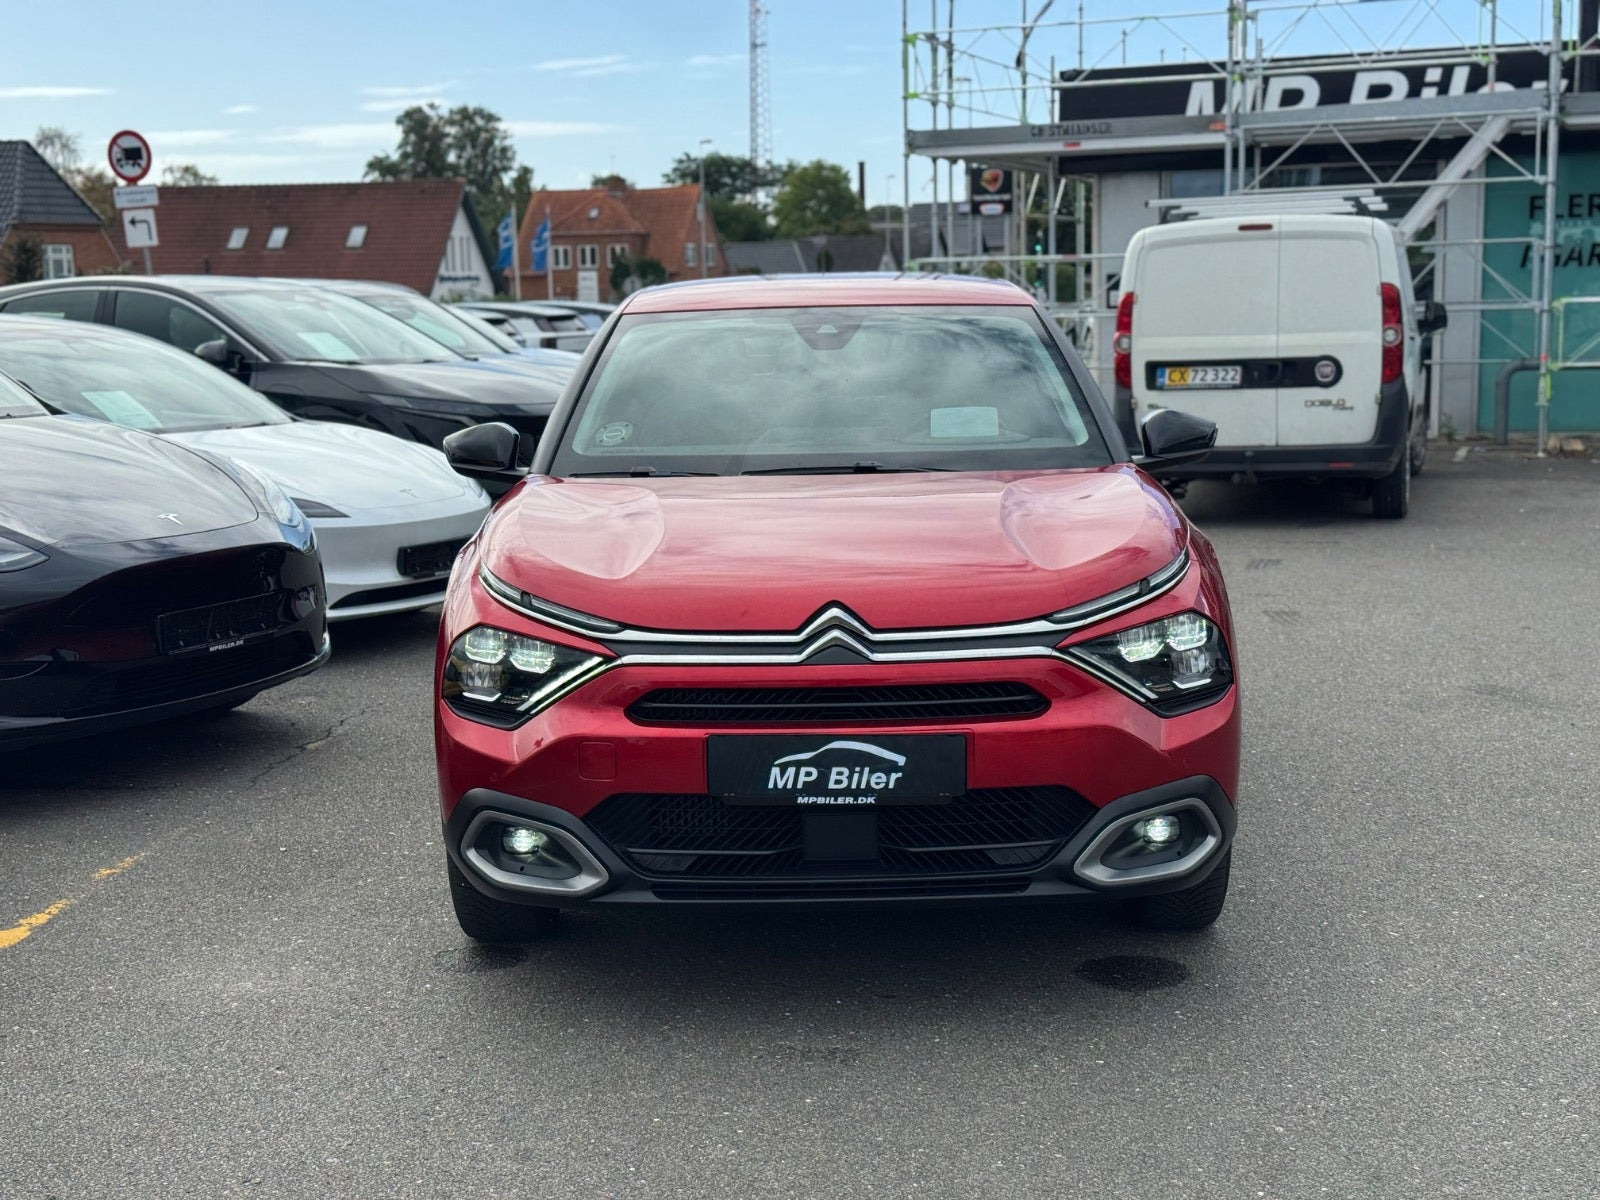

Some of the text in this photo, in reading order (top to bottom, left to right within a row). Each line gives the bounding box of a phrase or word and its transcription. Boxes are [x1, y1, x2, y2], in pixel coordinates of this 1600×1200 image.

[1168, 368, 1188, 383] CX
[1211, 368, 1239, 382] 322
[767, 766, 903, 790] MP Biler
[796, 796, 877, 805] MPBILER.DK
